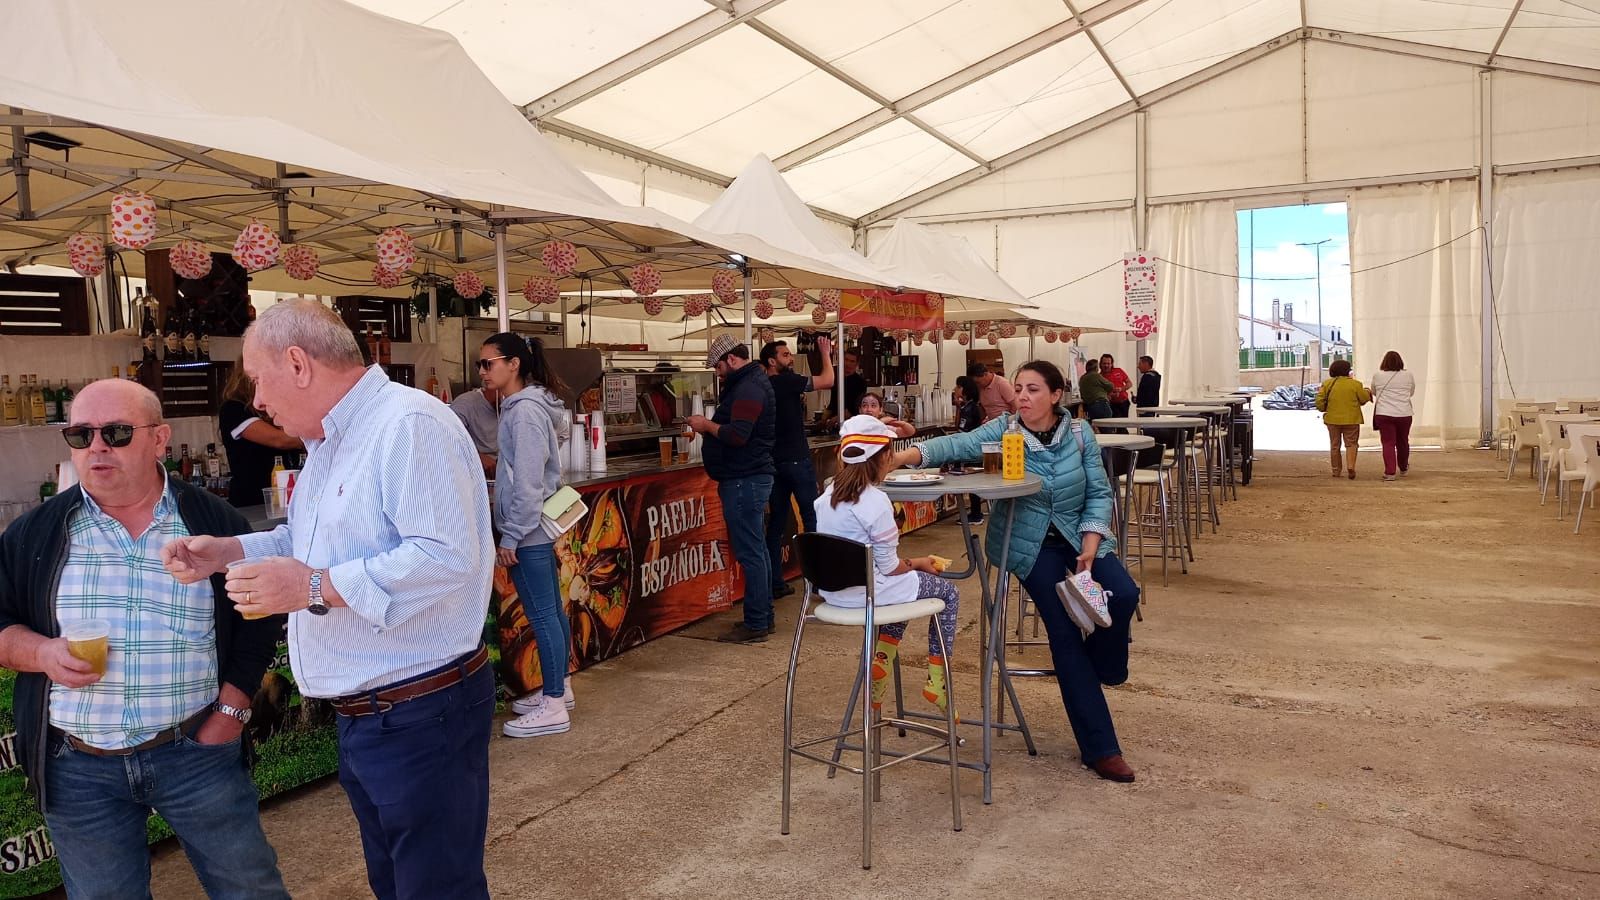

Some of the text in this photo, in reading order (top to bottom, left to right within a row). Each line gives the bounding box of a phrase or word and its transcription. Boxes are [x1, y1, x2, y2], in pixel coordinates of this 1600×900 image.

[647, 495, 706, 541] PAELLA
[640, 540, 725, 597] ESPAÑOLA
[0, 827, 58, 874] SAL
